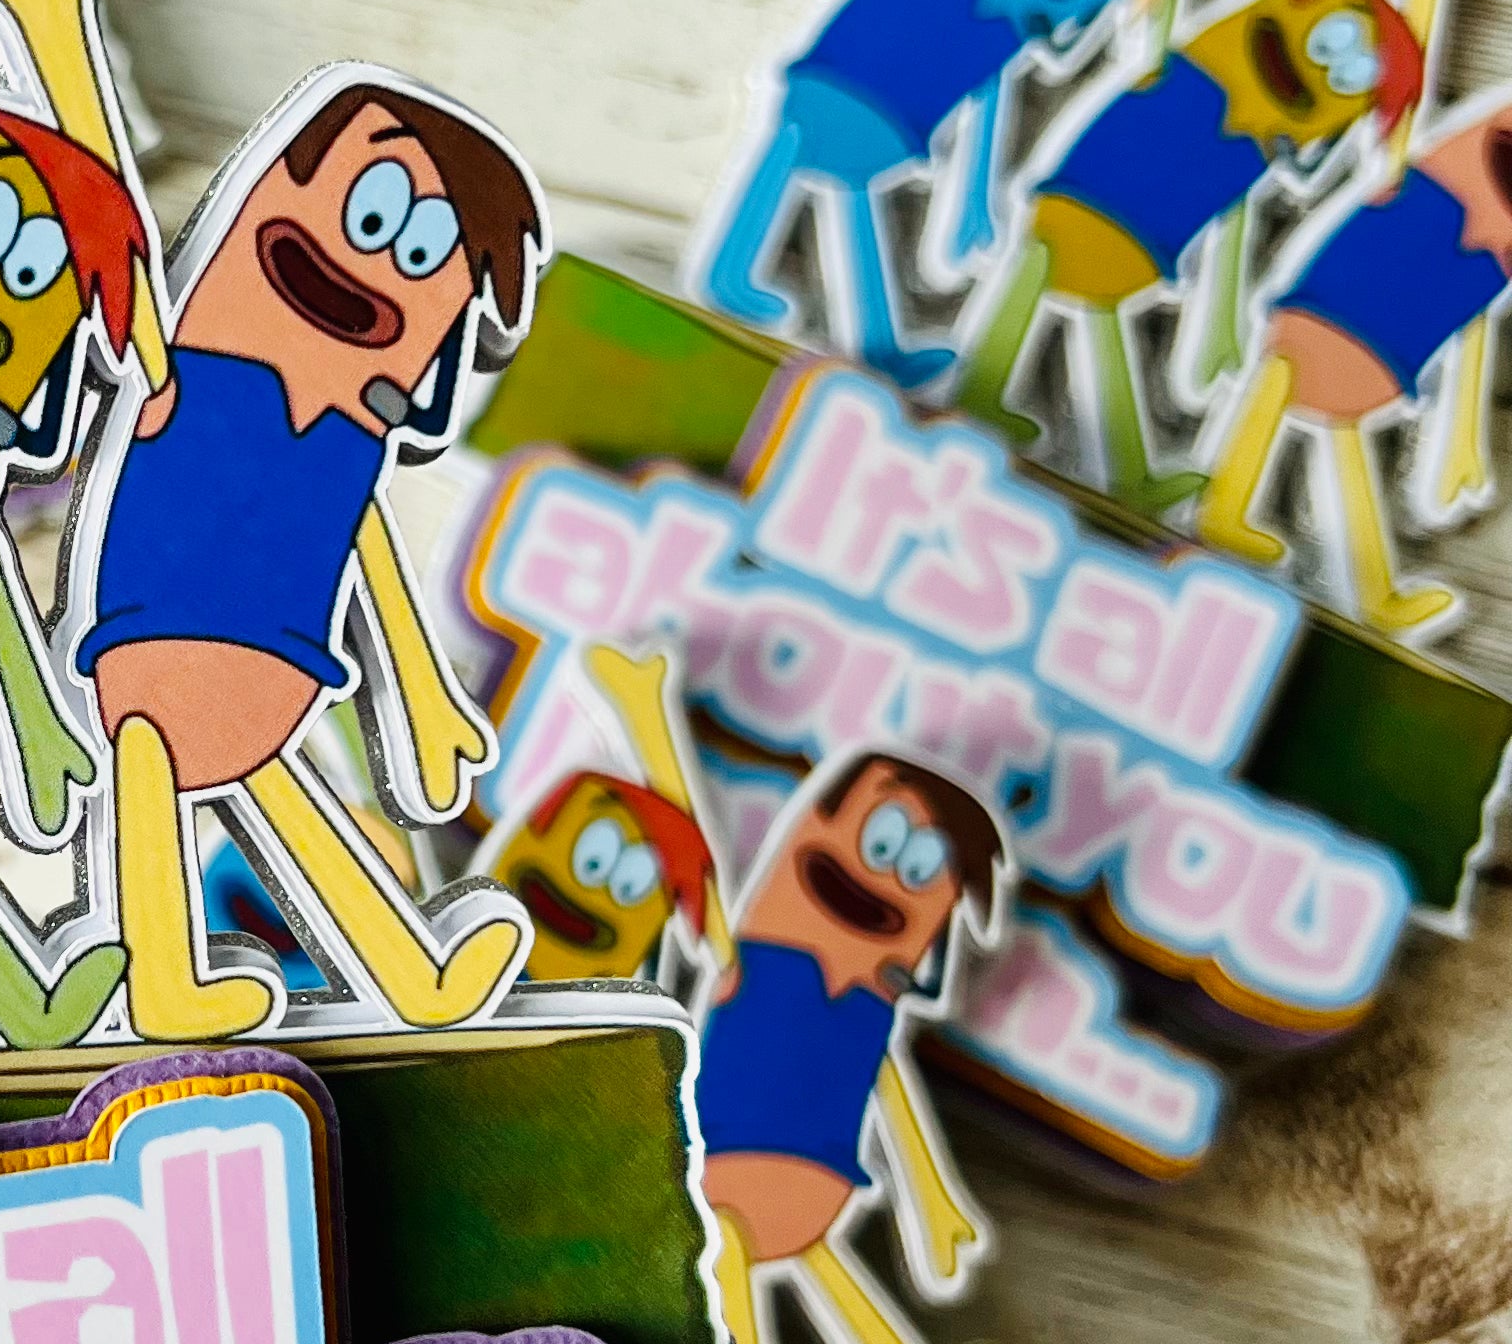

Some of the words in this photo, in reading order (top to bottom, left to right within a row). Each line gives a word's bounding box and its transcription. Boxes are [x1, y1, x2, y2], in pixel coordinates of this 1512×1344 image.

[772, 398, 1052, 639] It's
[1048, 582, 1272, 750] all
[1033, 741, 1378, 990] you
